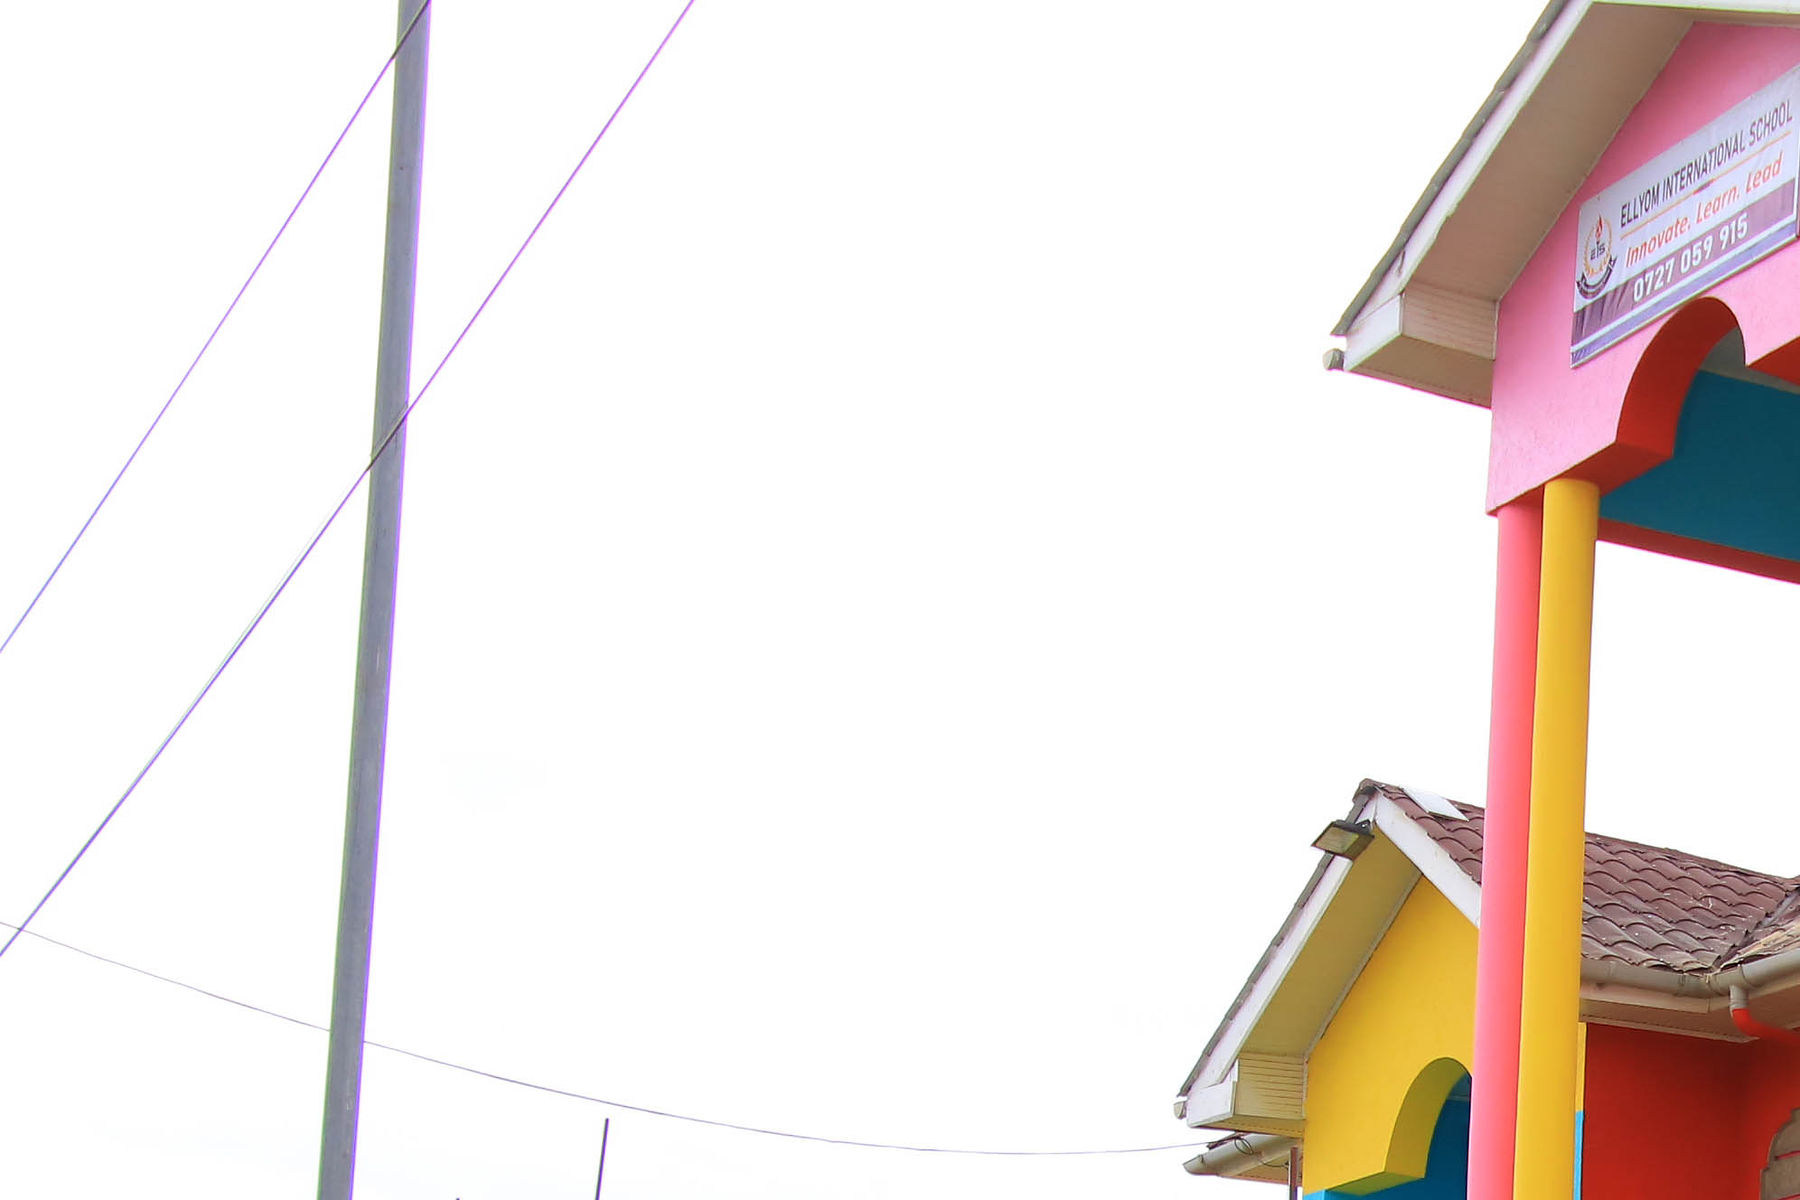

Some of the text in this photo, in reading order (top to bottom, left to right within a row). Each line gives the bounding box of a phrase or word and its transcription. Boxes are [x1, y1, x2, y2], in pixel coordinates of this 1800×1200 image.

[1620, 99, 1793, 228] ELLYOM INTERNATIONAL SCHOOL
[1625, 150, 1784, 268] Innovate. Learn. Lead
[1633, 257, 1675, 302] 0727
[1680, 235, 1714, 273] 059
[1719, 212, 1749, 250] 915
